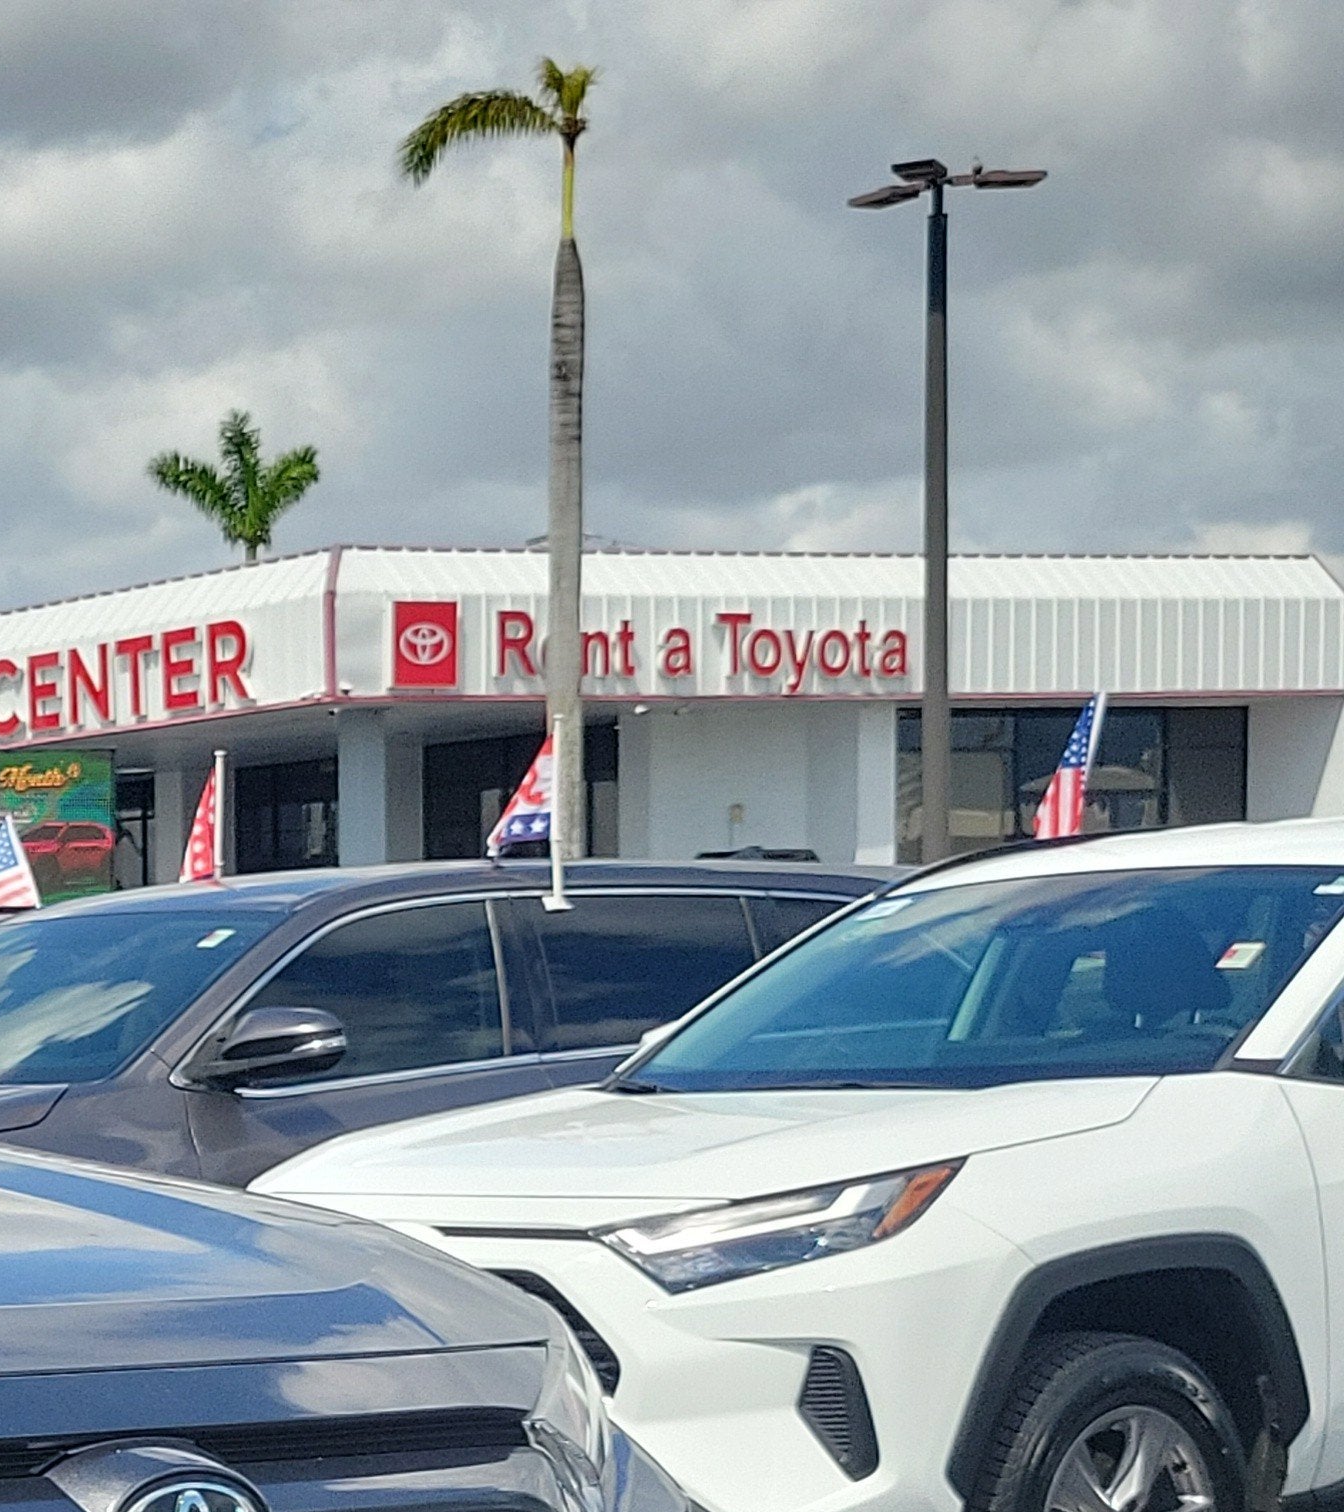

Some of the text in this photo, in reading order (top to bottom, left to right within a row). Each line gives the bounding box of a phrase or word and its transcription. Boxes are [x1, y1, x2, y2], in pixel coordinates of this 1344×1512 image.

[498, 611, 908, 693] Rnt a Toyota
